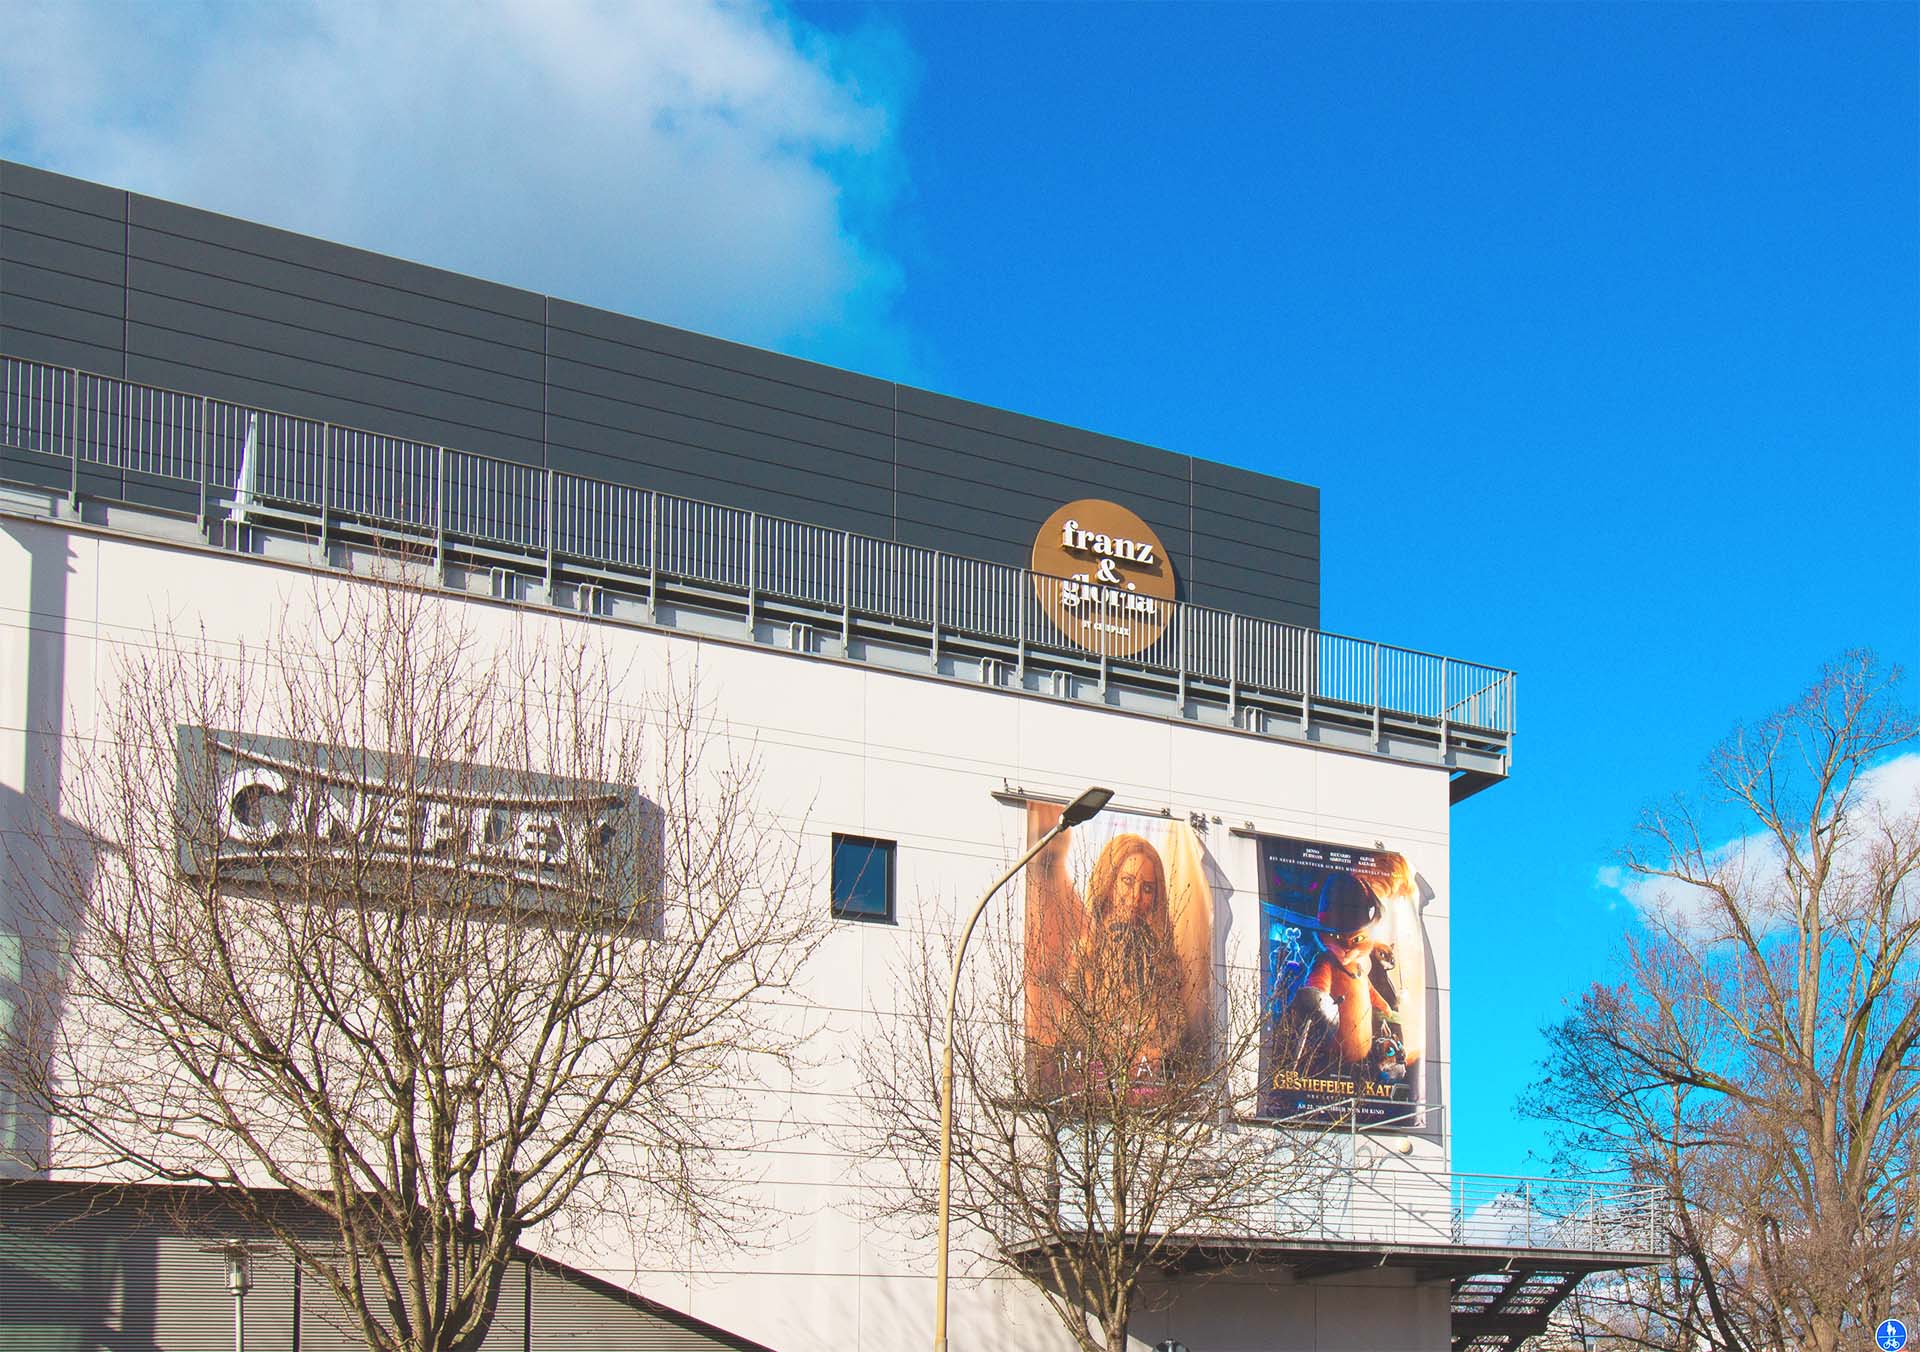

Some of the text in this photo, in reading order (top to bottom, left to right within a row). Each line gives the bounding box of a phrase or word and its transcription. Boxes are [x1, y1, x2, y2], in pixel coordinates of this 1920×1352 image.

[1061, 519, 1154, 565] franz
[1096, 557, 1120, 583] &
[1061, 573, 1156, 615] gloria
[1272, 1072, 1394, 1098] GESTIEFELTE KAT
